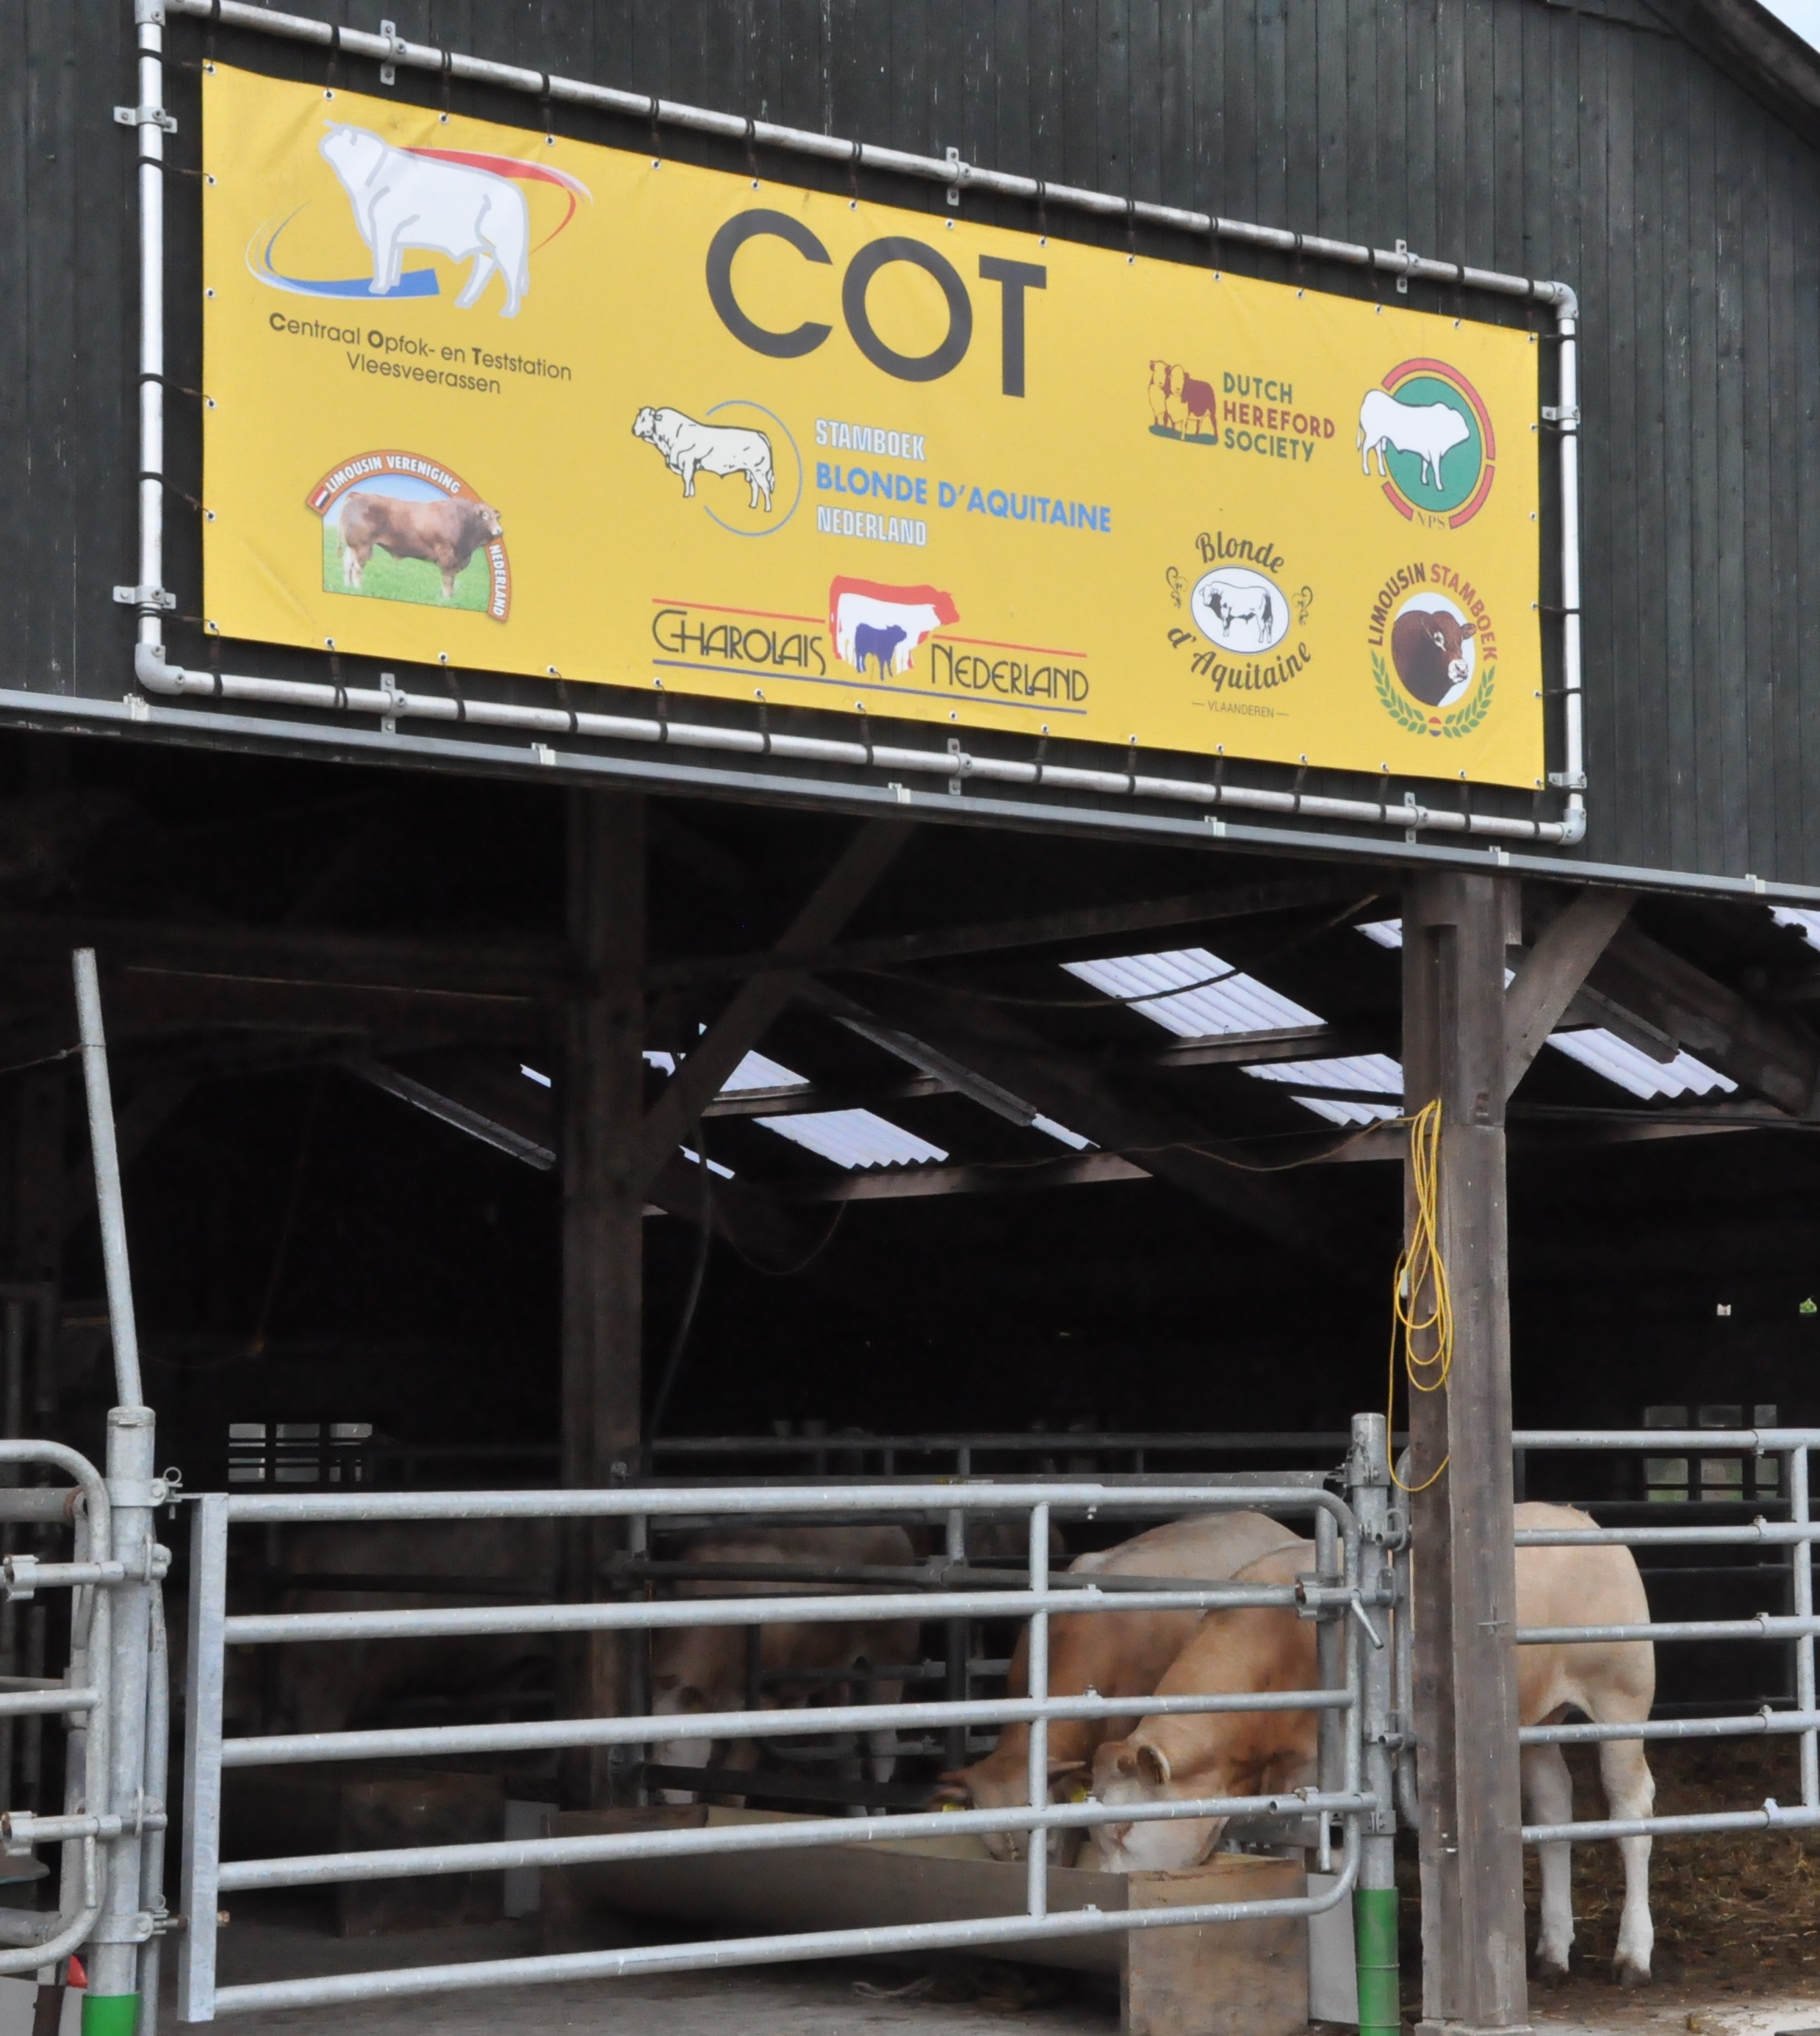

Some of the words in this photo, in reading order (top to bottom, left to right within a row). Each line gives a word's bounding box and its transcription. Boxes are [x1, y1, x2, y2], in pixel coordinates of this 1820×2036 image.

[706, 208, 1046, 398] COT
[269, 312, 361, 345] Centraal
[367, 330, 436, 356] Opfok-
[441, 345, 466, 362] en
[471, 348, 572, 381] Teststation
[347, 351, 501, 394] Vleesveerassen
[1223, 372, 1292, 404] DUTCH
[816, 418, 927, 461] STAMBOEK
[1223, 400, 1335, 439] HEREFORD
[1223, 428, 1314, 462] SOCIETY
[816, 462, 927, 506] BLONDE
[325, 456, 382, 493] LIMOUSIN
[386, 456, 461, 494] VERENIGING
[489, 544, 508, 616] NEDERLAND
[816, 505, 927, 547] NEDERLAND
[1416, 511, 1445, 530] NPS
[1195, 530, 1284, 573] Blonde
[1368, 562, 1425, 646] LIMOUSIN
[1431, 564, 1498, 662] STAMBOEK
[652, 608, 827, 676] CHAROLAIS
[931, 643, 1089, 702] NEDERLAND
